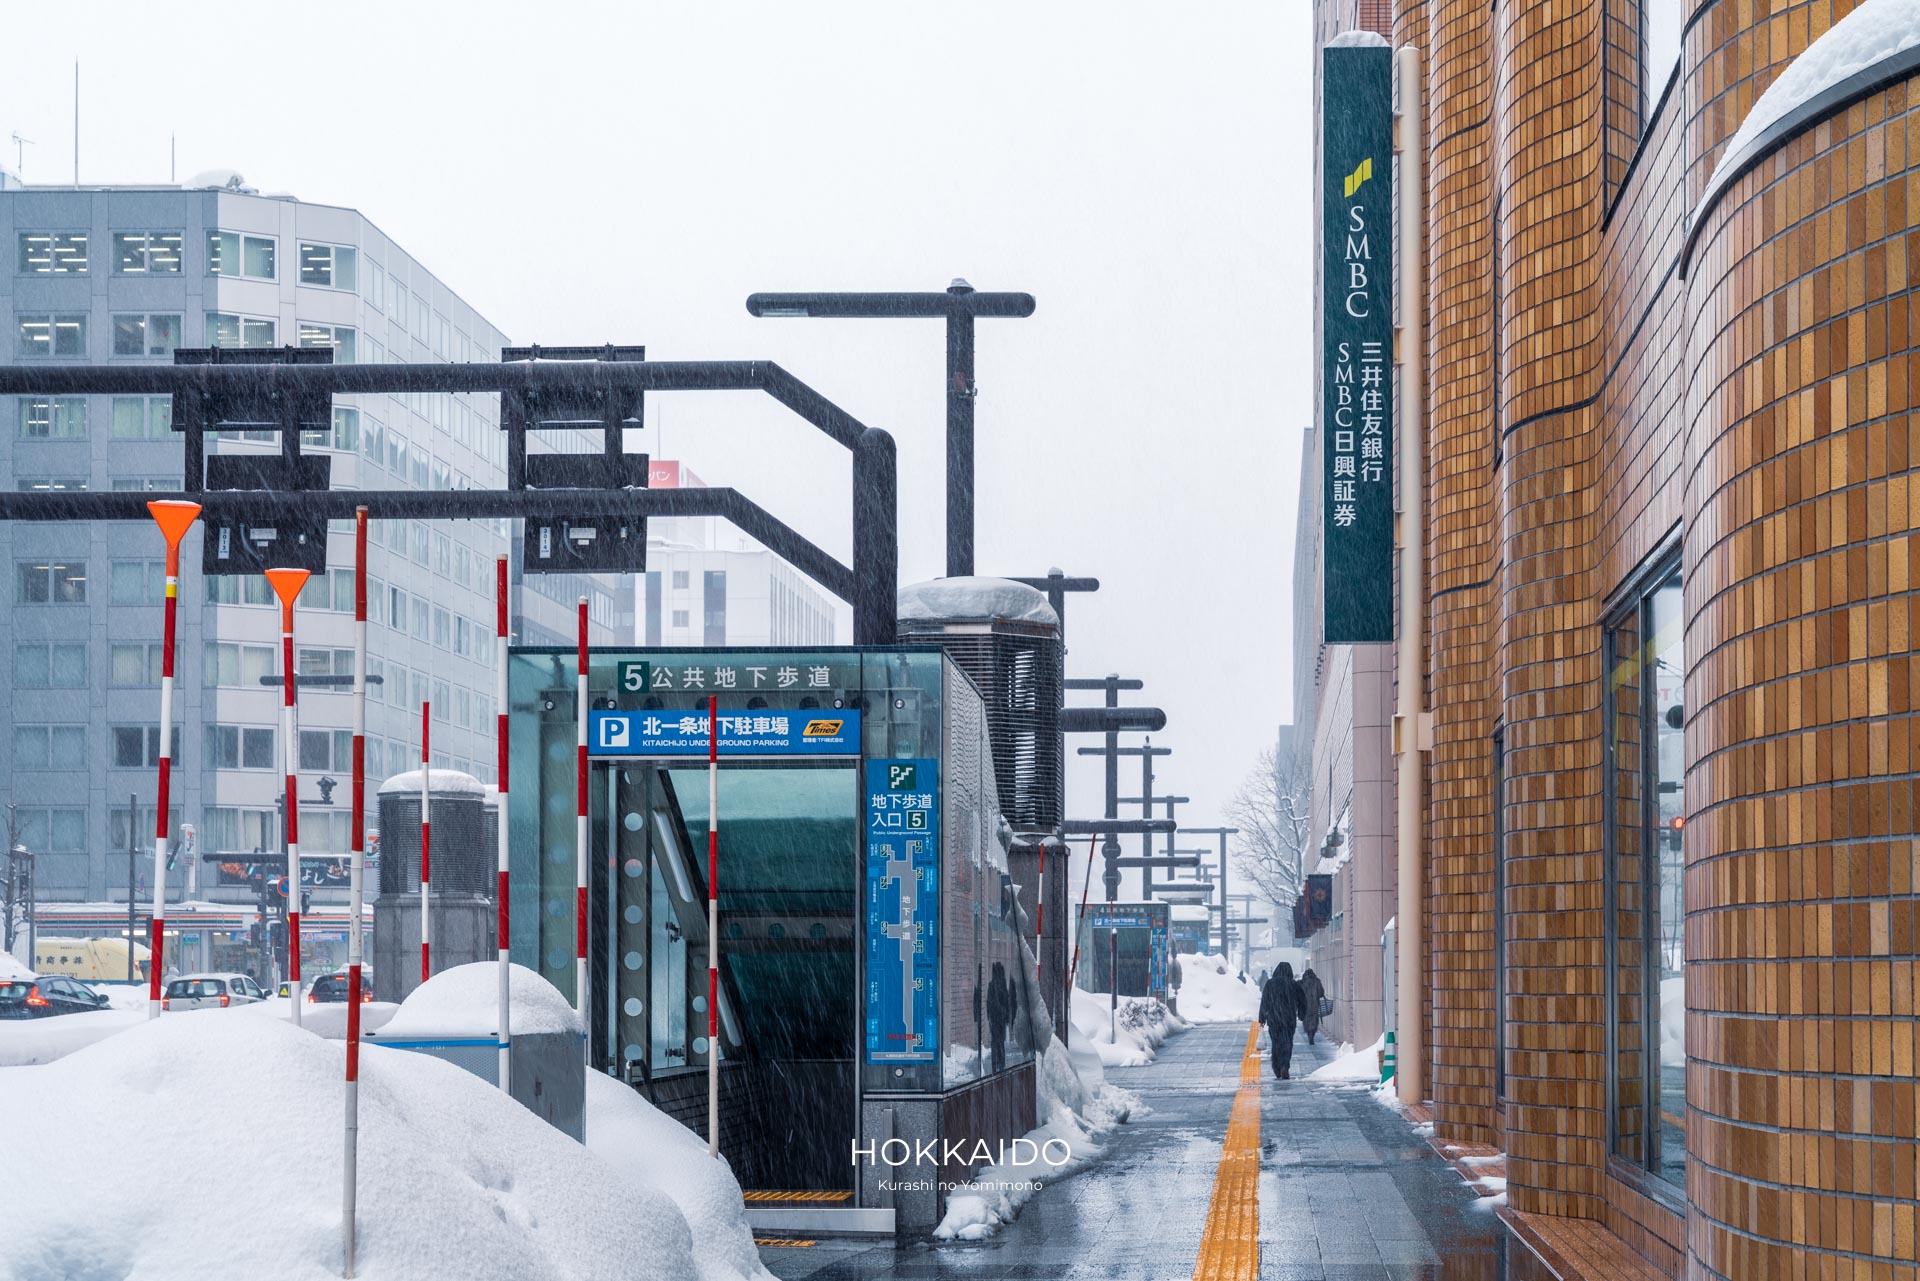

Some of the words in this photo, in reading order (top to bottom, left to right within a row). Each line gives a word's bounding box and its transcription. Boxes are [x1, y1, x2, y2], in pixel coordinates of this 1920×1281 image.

[1344, 206, 1372, 318] SMBC
[1361, 341, 1384, 482] 三井住友銀行
[1334, 342, 1356, 527] SMBC日興証券
[624, 664, 643, 691] 5
[651, 665, 831, 689] 公共地下歩道
[643, 717, 789, 735] 北一条地下駐車場
[808, 722, 840, 734] Times
[643, 739, 687, 747] KITAICHIJO
[689, 739, 751, 747] UNDEGROUND
[753, 739, 789, 747] PARKING
[890, 766, 900, 778] P
[871, 793, 933, 809] 地下歩道
[871, 812, 902, 828] 入口
[911, 813, 922, 827] 5
[902, 895, 911, 940] 地下歩道
